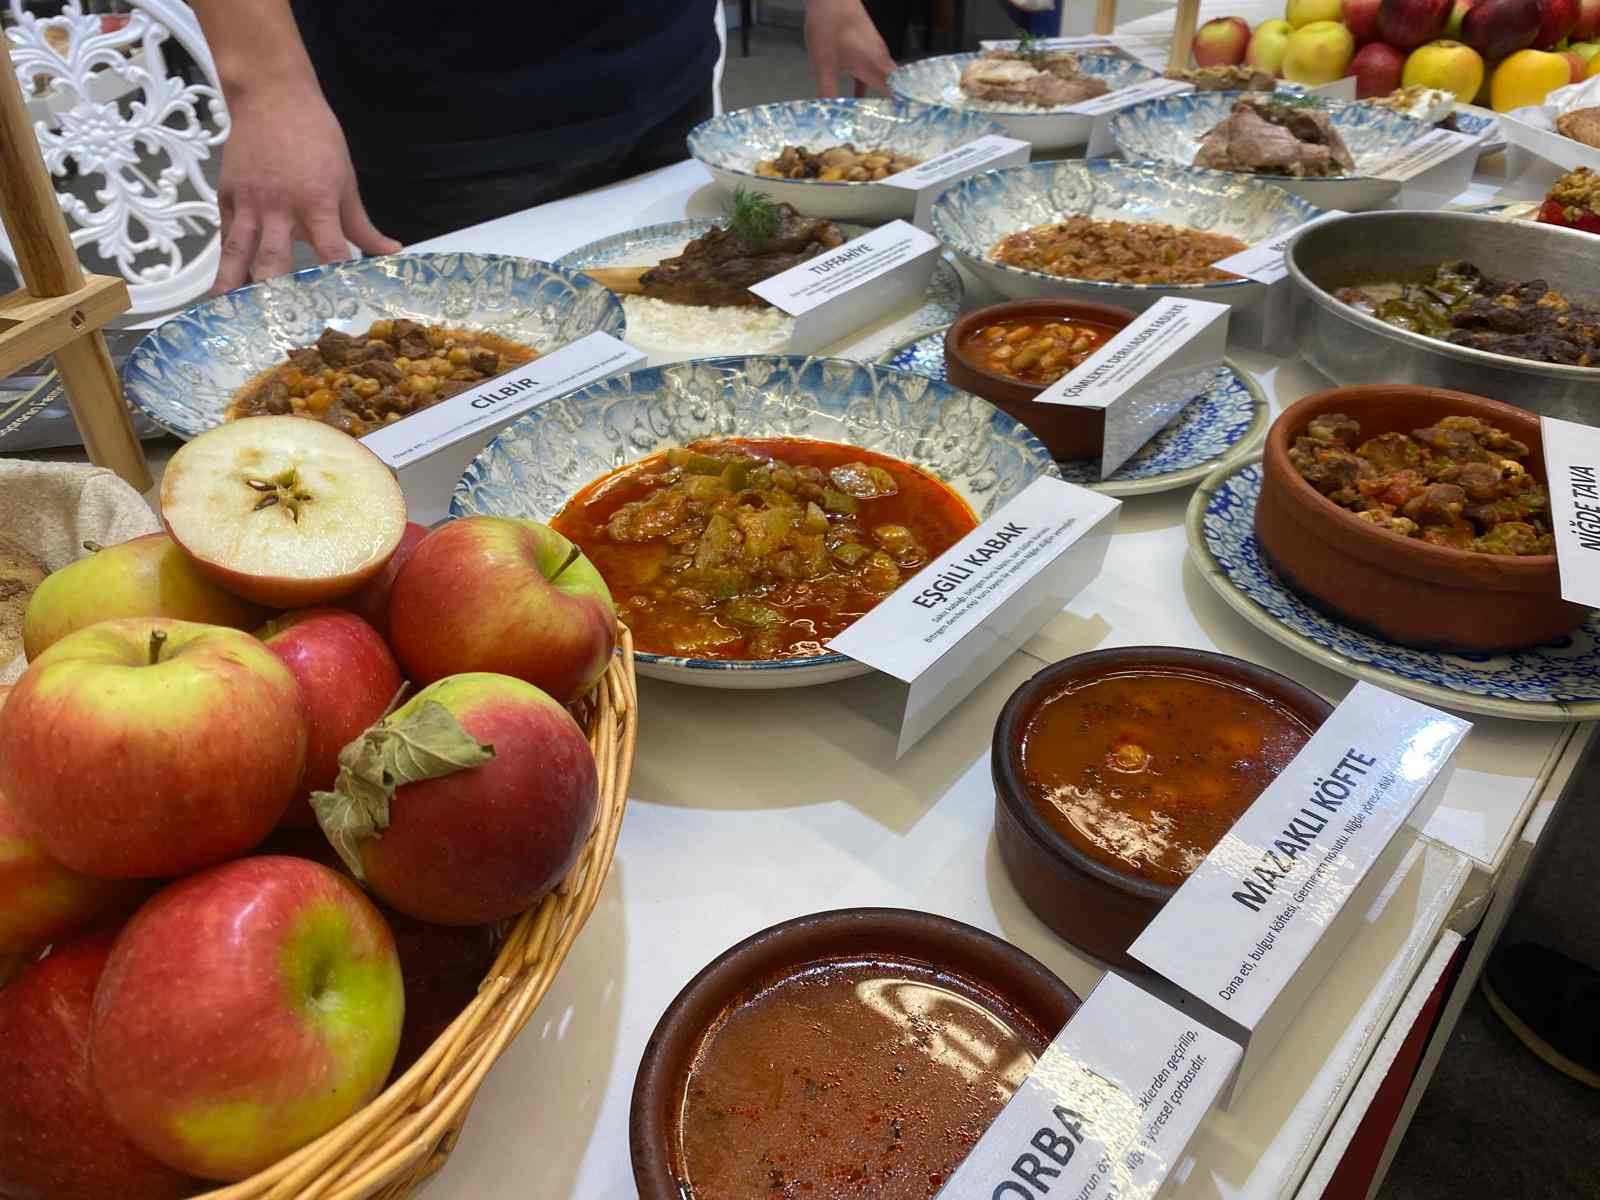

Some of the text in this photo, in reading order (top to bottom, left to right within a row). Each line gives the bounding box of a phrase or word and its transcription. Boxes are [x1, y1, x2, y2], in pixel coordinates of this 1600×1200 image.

[1568, 465, 1600, 501] TAVA
[912, 564, 974, 608] EŞGİLİ
[964, 521, 1028, 567] KABAK
[1231, 747, 1377, 913] MAZAKLI KÖFTE
[1271, 903, 1301, 937] köftesi,
[1248, 931, 1277, 962] bulgur
[1240, 958, 1257, 977] eti,
[1218, 975, 1244, 1001] Dana
[1166, 1030, 1199, 1071] geçirilip,
[1146, 1100, 1174, 1144] yöresel
[1170, 1054, 1208, 1105] çorbasıdır.
